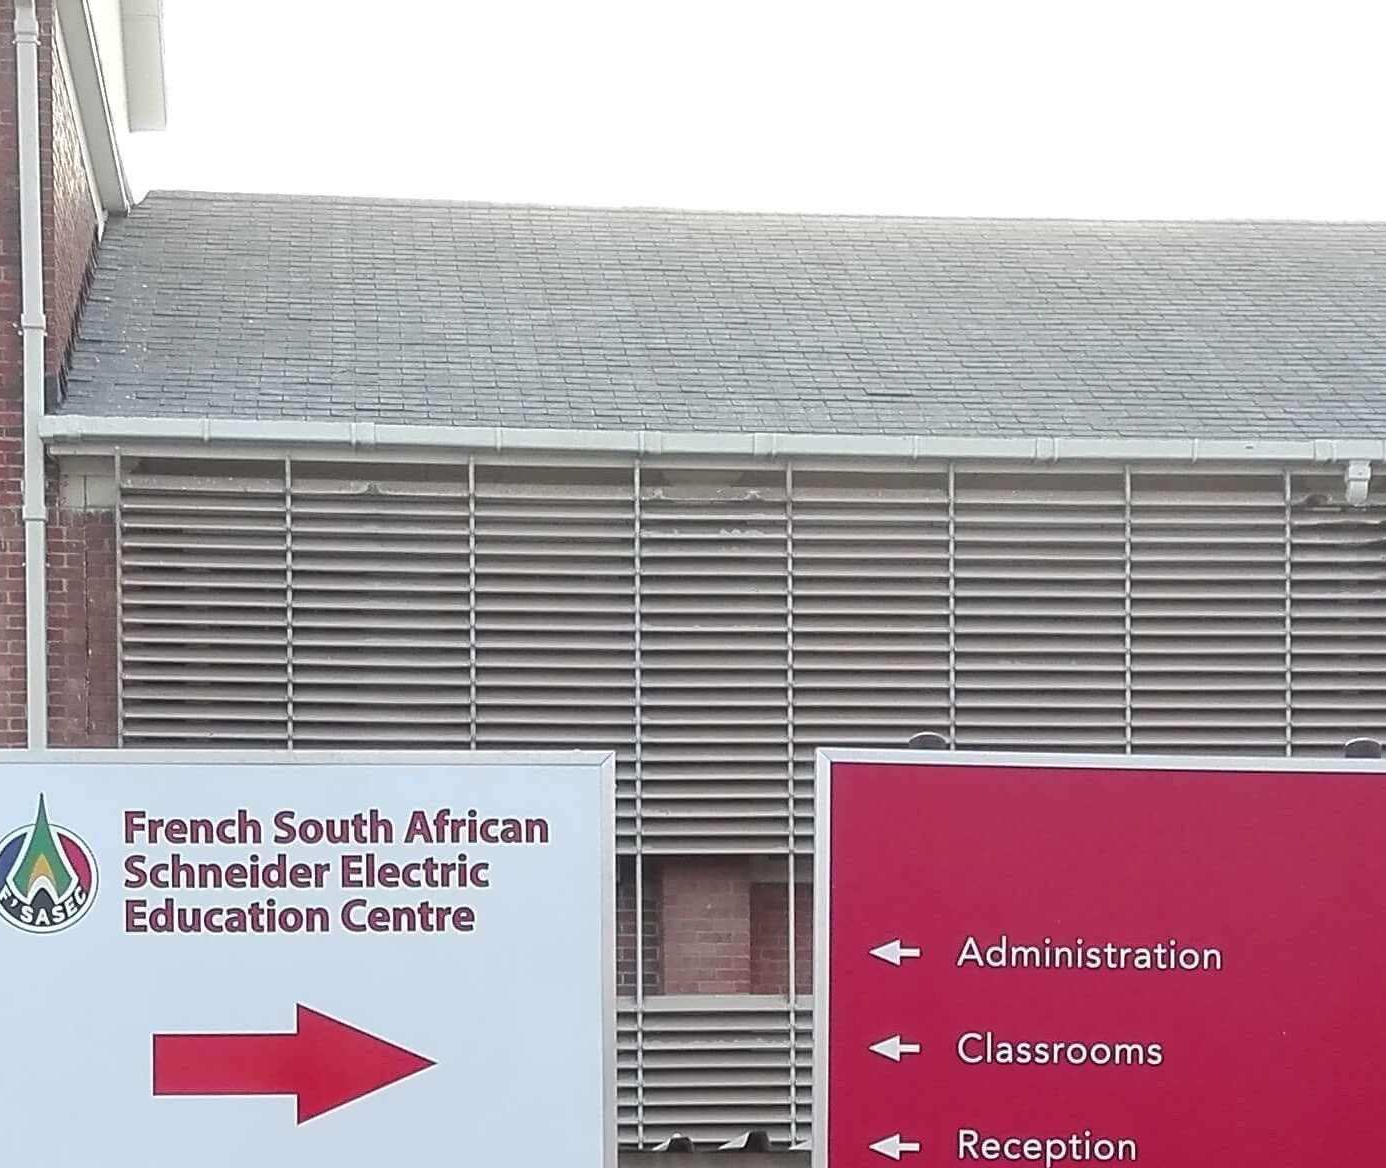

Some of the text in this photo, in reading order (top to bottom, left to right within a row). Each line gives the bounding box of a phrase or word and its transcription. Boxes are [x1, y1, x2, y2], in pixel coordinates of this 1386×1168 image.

[124, 808, 549, 845] French South African
[124, 852, 490, 889] Schneider Electric
[125, 897, 475, 933] Education Centre
[957, 935, 1221, 970] Administration
[957, 1031, 1162, 1065] Classrooms
[959, 1129, 1136, 1168] Reception
